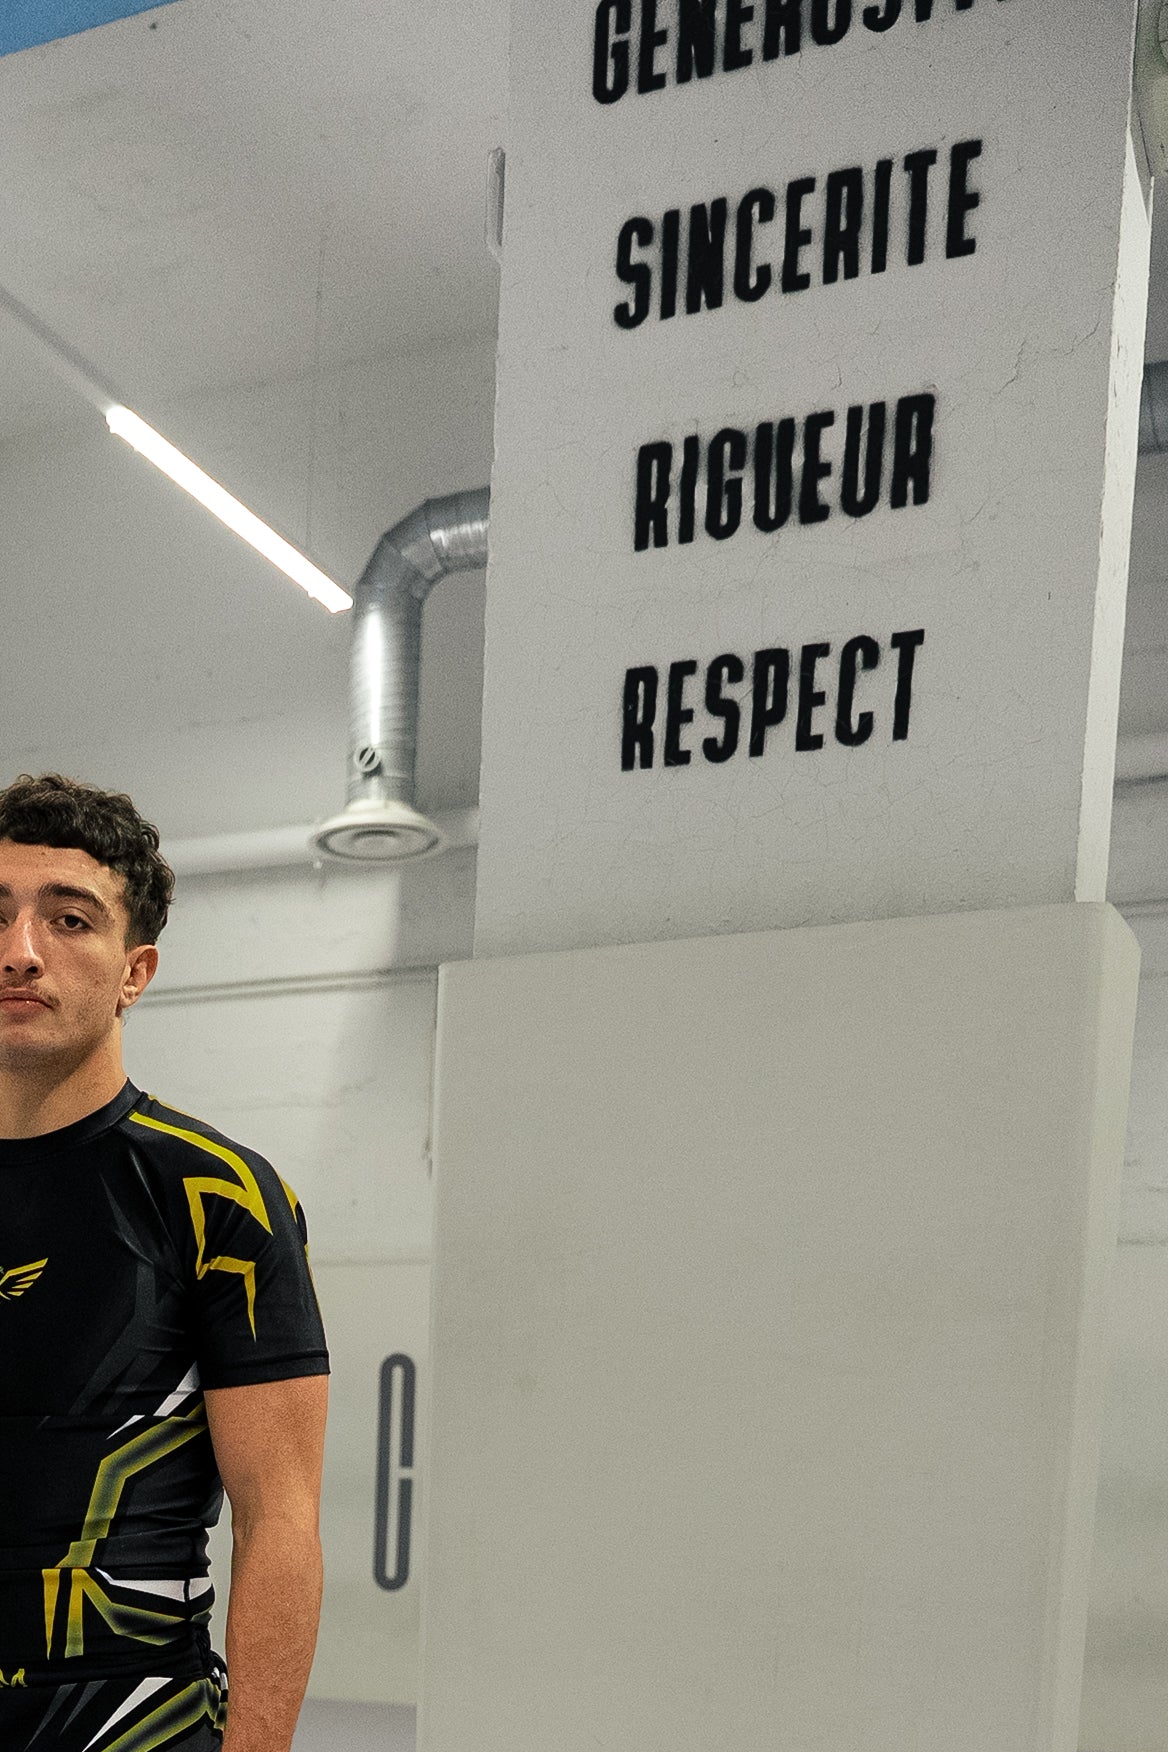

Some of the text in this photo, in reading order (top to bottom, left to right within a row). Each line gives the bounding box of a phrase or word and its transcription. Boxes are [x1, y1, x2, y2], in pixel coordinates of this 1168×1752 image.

[613, 138, 984, 331] SINCERITE
[633, 392, 937, 553] RIGUEUR
[620, 628, 925, 772] RESPECT
